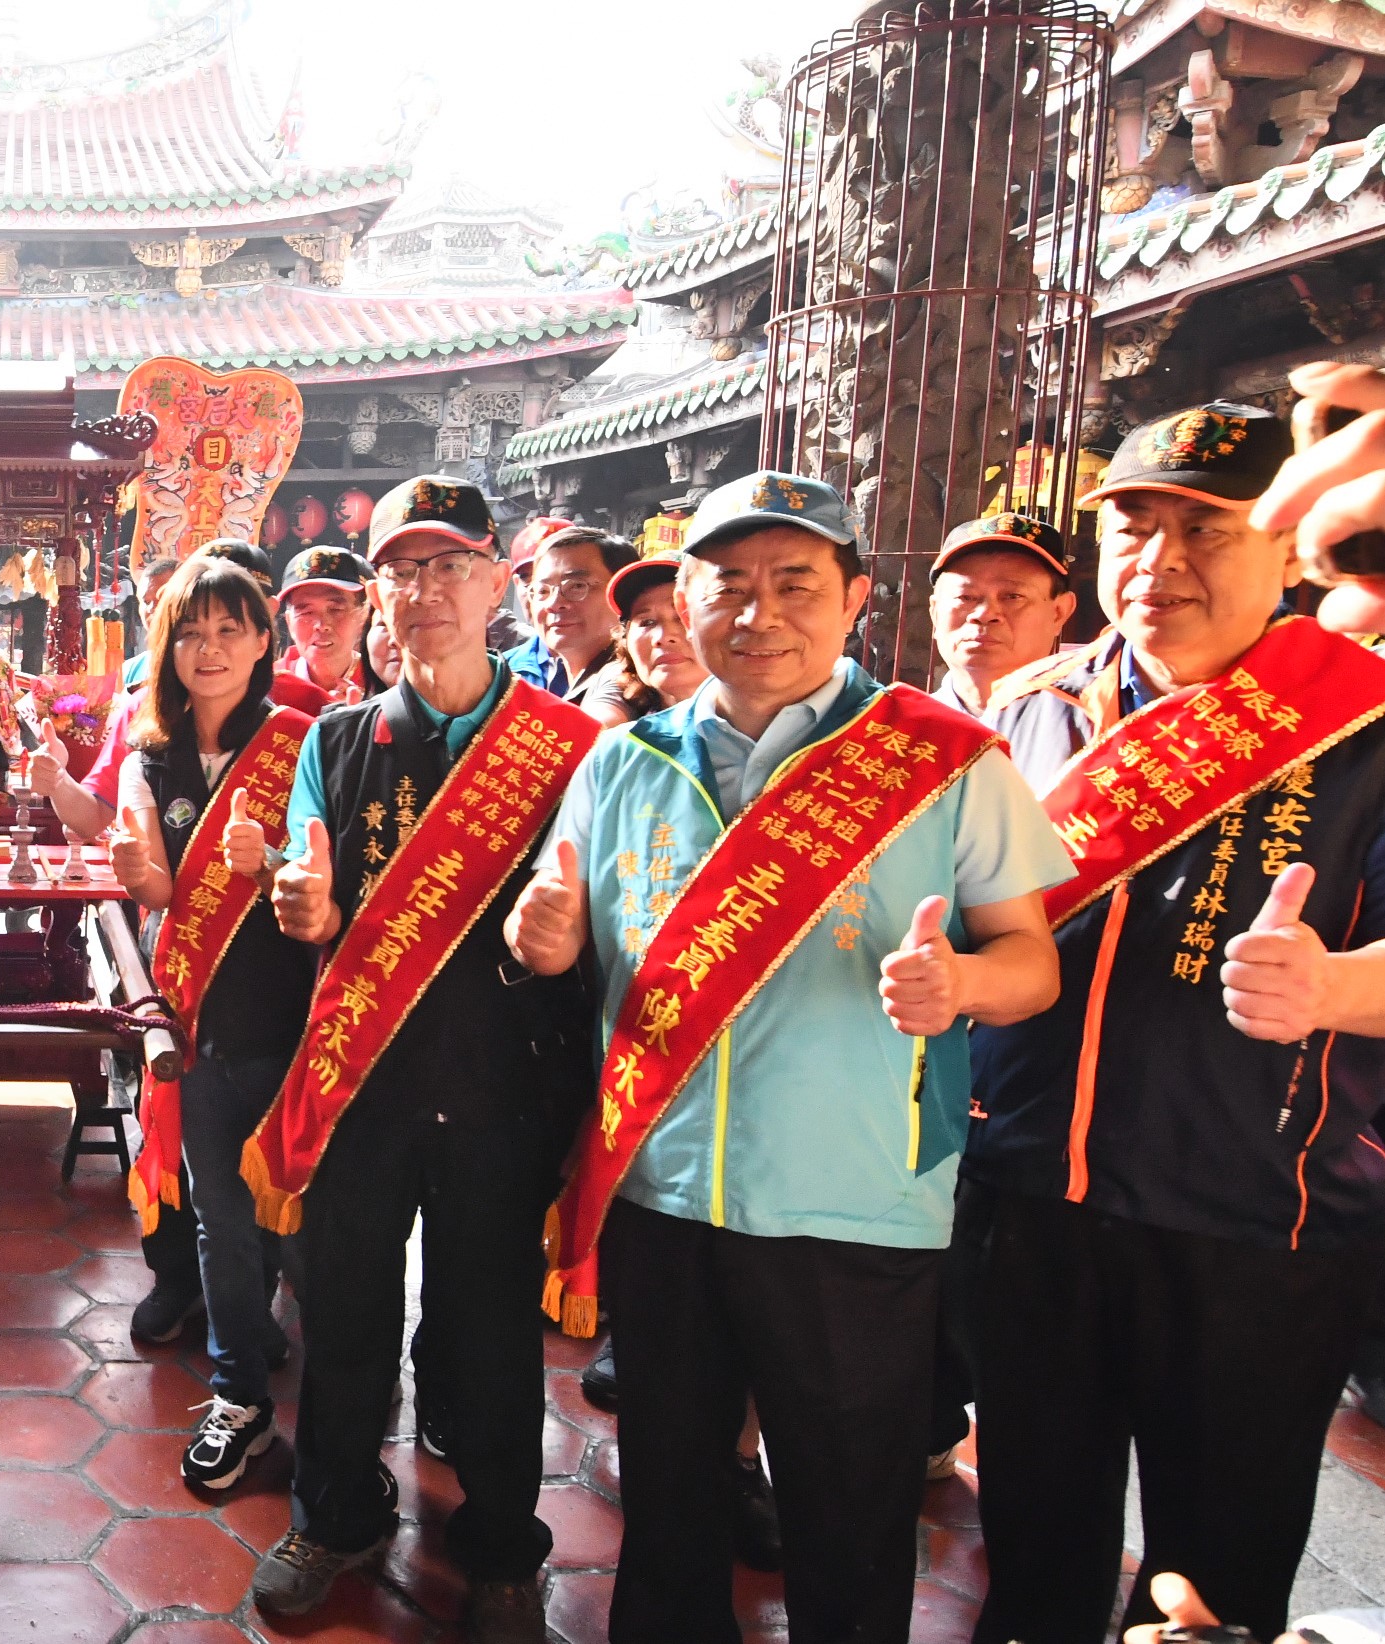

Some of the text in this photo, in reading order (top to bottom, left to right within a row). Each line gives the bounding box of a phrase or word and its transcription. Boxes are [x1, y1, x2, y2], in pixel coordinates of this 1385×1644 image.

[1183, 688, 1265, 761] 同安寮
[1223, 667, 1303, 733] 甲辰年
[505, 721, 564, 766] 民國113年
[515, 710, 573, 754] 2024
[863, 719, 938, 763] 甲辰年
[1152, 719, 1226, 787] 十二庄
[486, 752, 544, 799] 甲辰年
[494, 735, 556, 785] 同安寮十二庄
[832, 739, 912, 792] 同安寮
[1117, 738, 1195, 810] 請媽祖
[245, 793, 282, 829] 媽祖
[783, 789, 864, 845] 請媽祖
[810, 766, 884, 819] 十二庄
[1083, 765, 1165, 833] 慶安宮
[445, 808, 509, 853] 安和宮
[758, 811, 842, 868] 福安宮
[832, 872, 871, 950] 安宮
